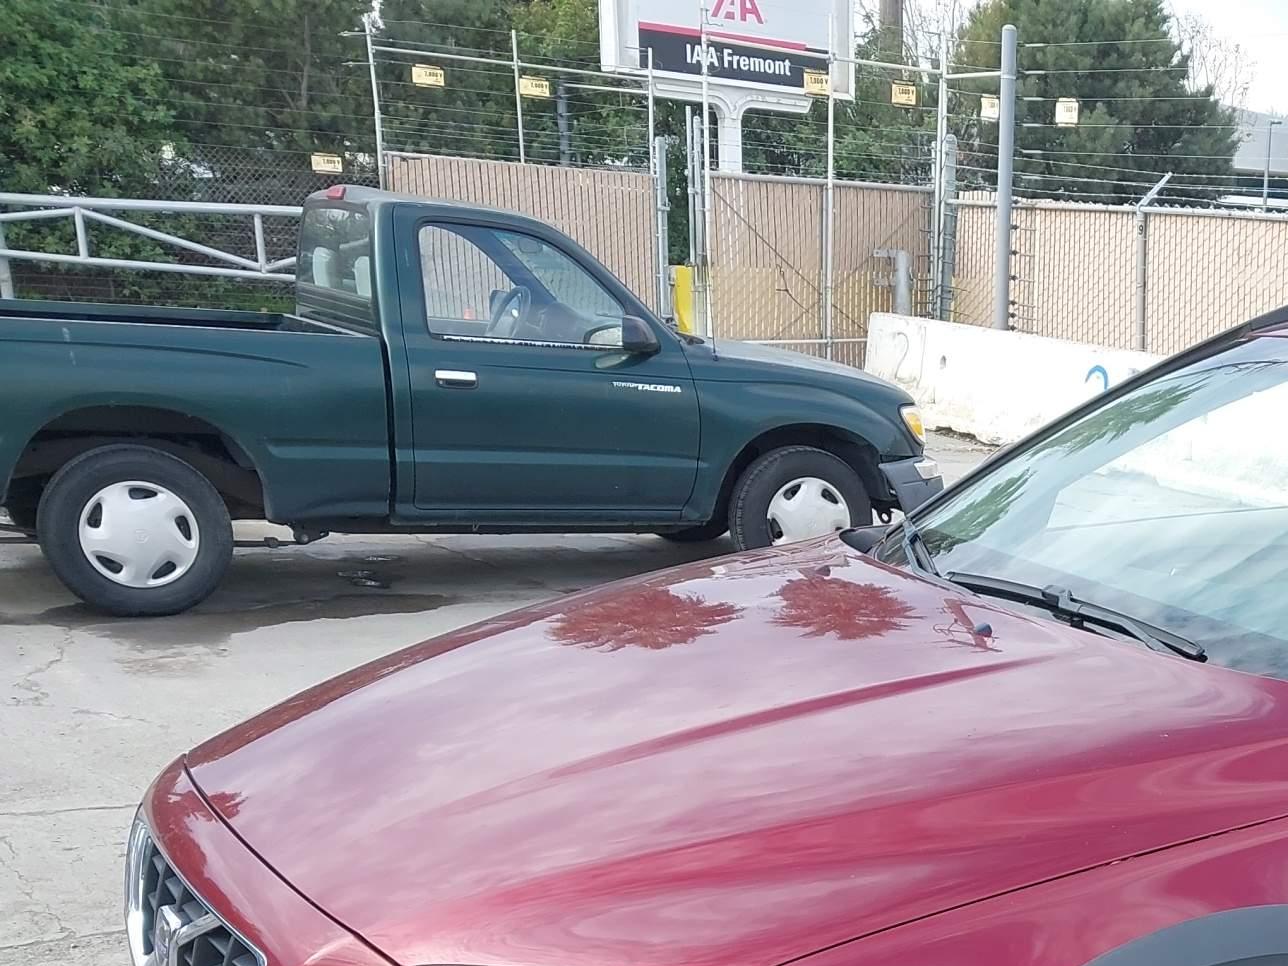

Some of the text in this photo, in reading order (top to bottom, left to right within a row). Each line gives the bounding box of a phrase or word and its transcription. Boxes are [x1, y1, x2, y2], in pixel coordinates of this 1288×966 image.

[686, 43, 791, 76] IAA Fremont
[637, 383, 682, 393] TACOMA
